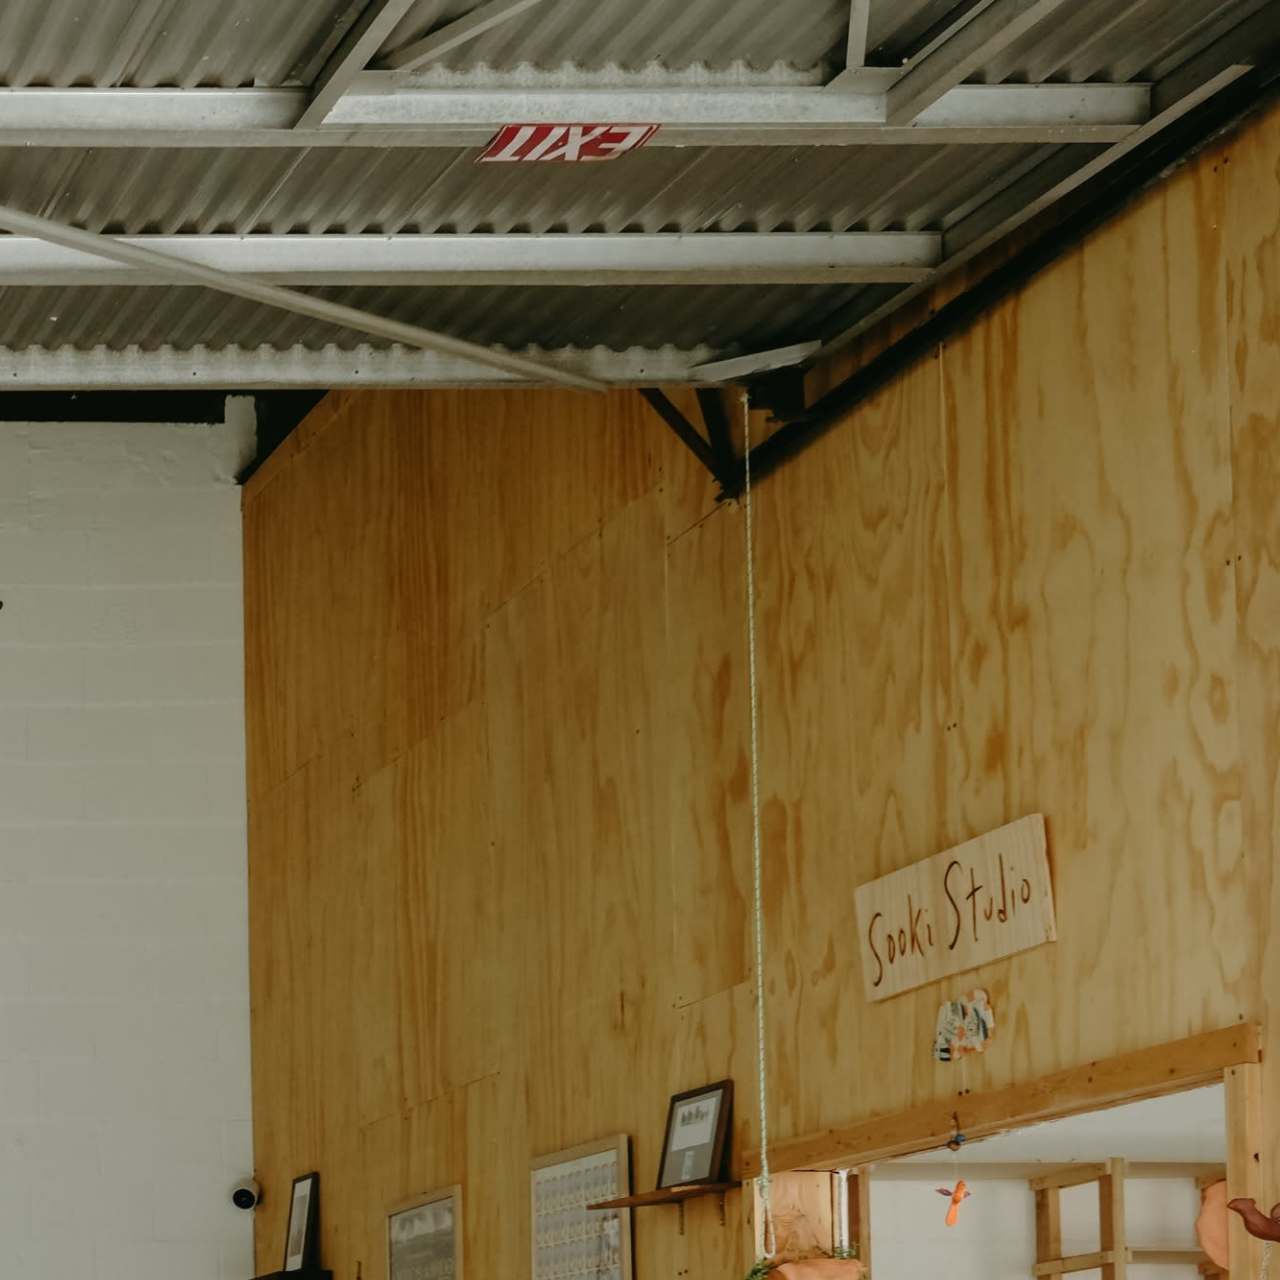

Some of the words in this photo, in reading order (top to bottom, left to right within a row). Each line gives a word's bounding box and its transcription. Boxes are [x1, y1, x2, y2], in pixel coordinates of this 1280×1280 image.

[480, 126, 652, 163] EXIT
[868, 894, 934, 987] Sooki
[944, 854, 1032, 950] Studio
